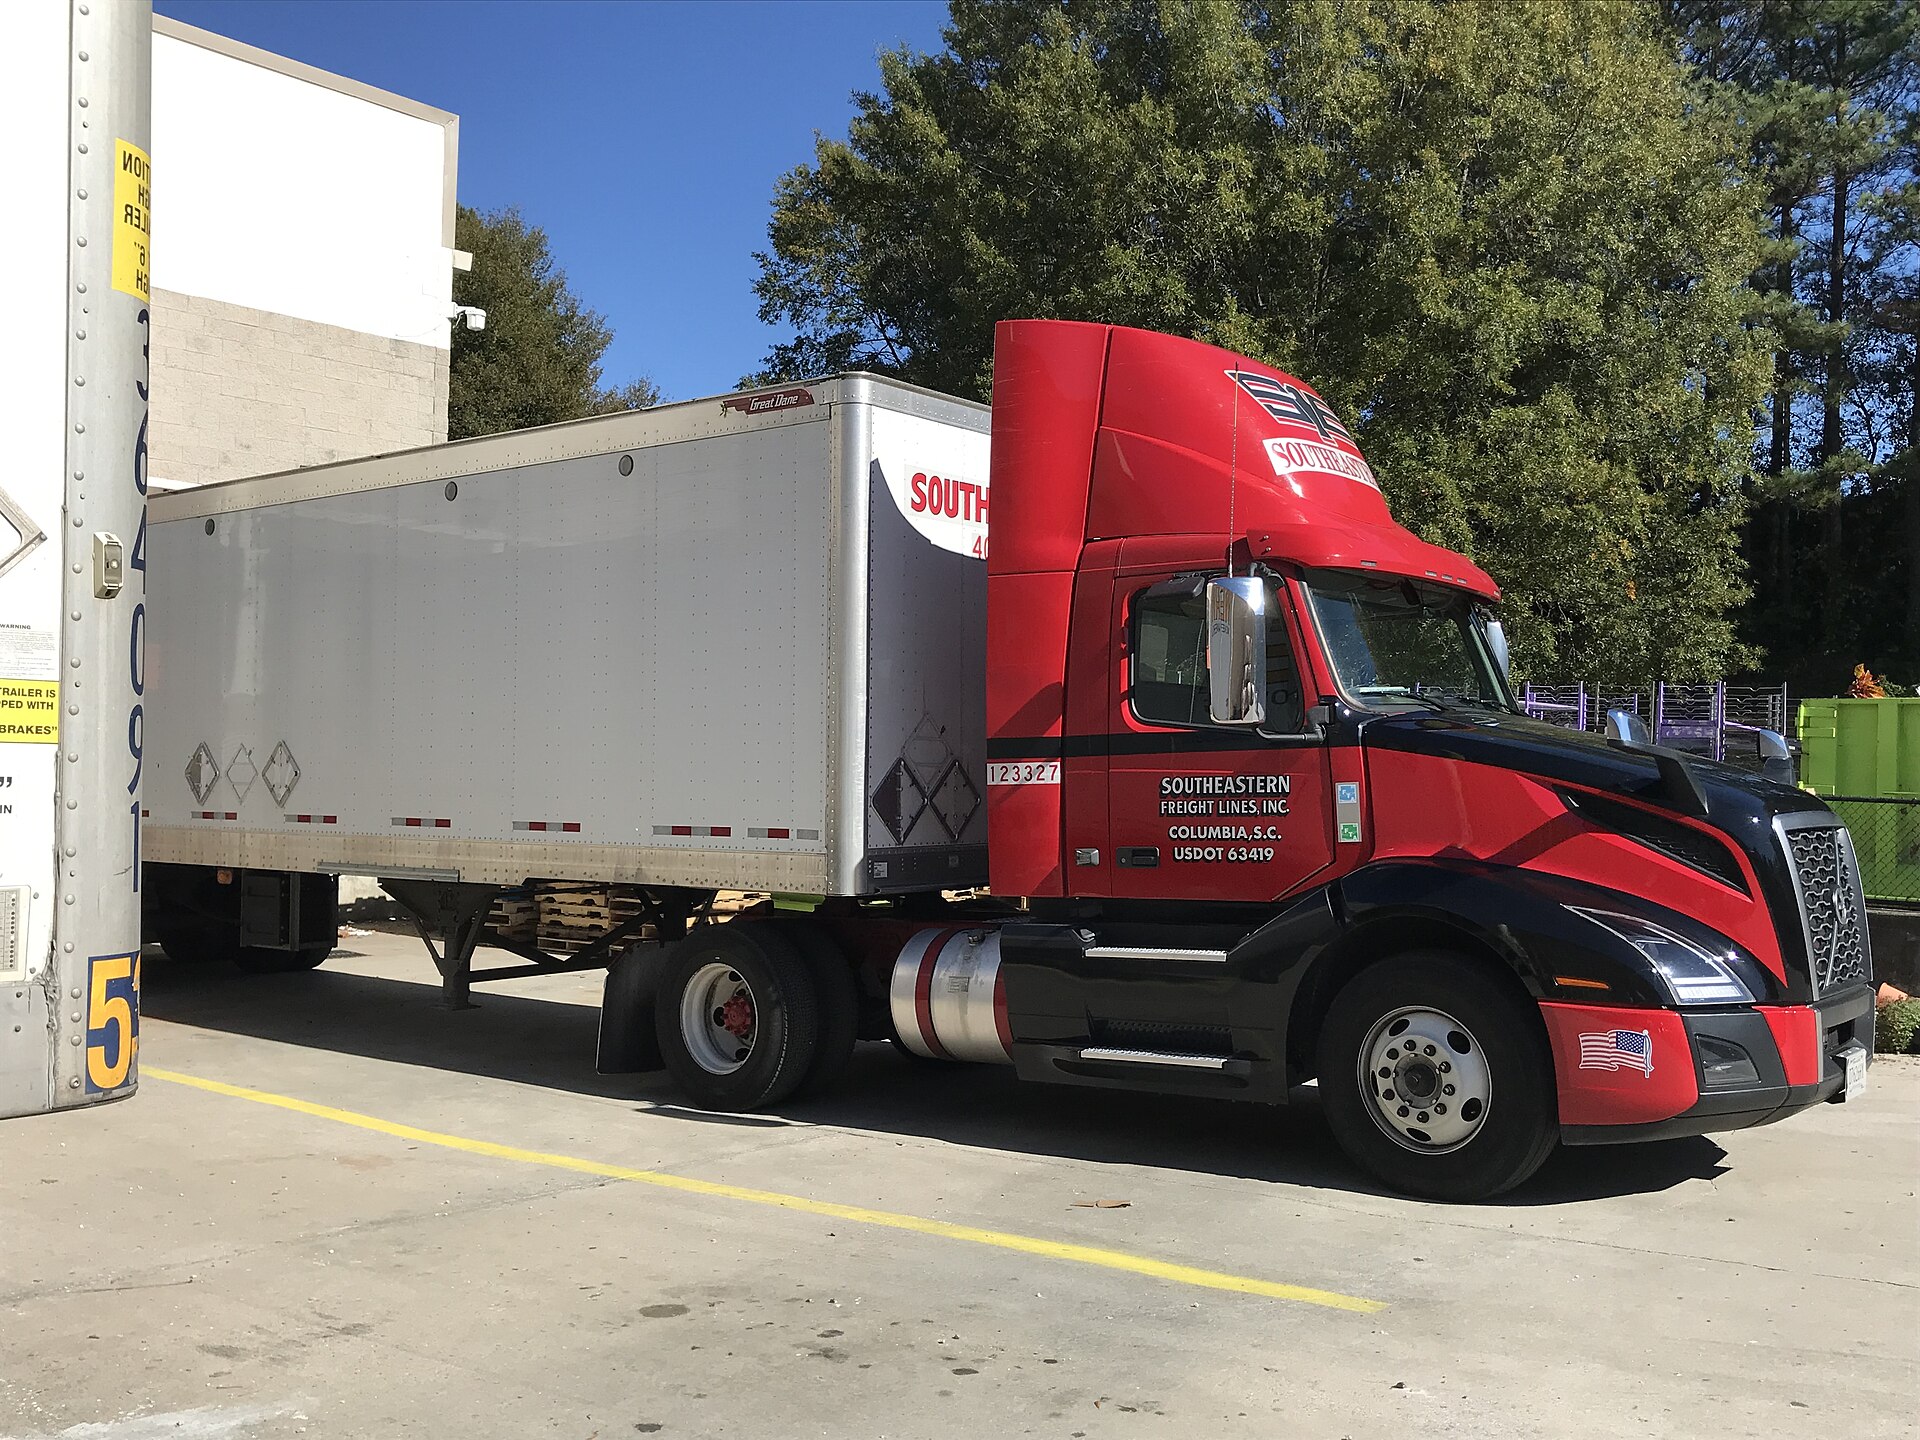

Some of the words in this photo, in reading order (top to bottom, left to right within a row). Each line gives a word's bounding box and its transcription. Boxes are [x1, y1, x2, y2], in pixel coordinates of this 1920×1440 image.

[750, 398, 773, 410] Great
[774, 394, 798, 407] Dane
[911, 472, 989, 524] SOUTH
[46, 689, 56, 698] IS
[0, 699, 23, 709] PED
[27, 701, 54, 710] WITH
[990, 764, 1059, 782] 123327
[1161, 775, 1290, 795] SOUTHEASTERN
[1160, 800, 1215, 814] FREIGHT
[1219, 799, 1260, 816] LINES,
[1263, 799, 1290, 814] INC.
[1174, 847, 1224, 860] USDOT
[1227, 847, 1275, 861] 63419
